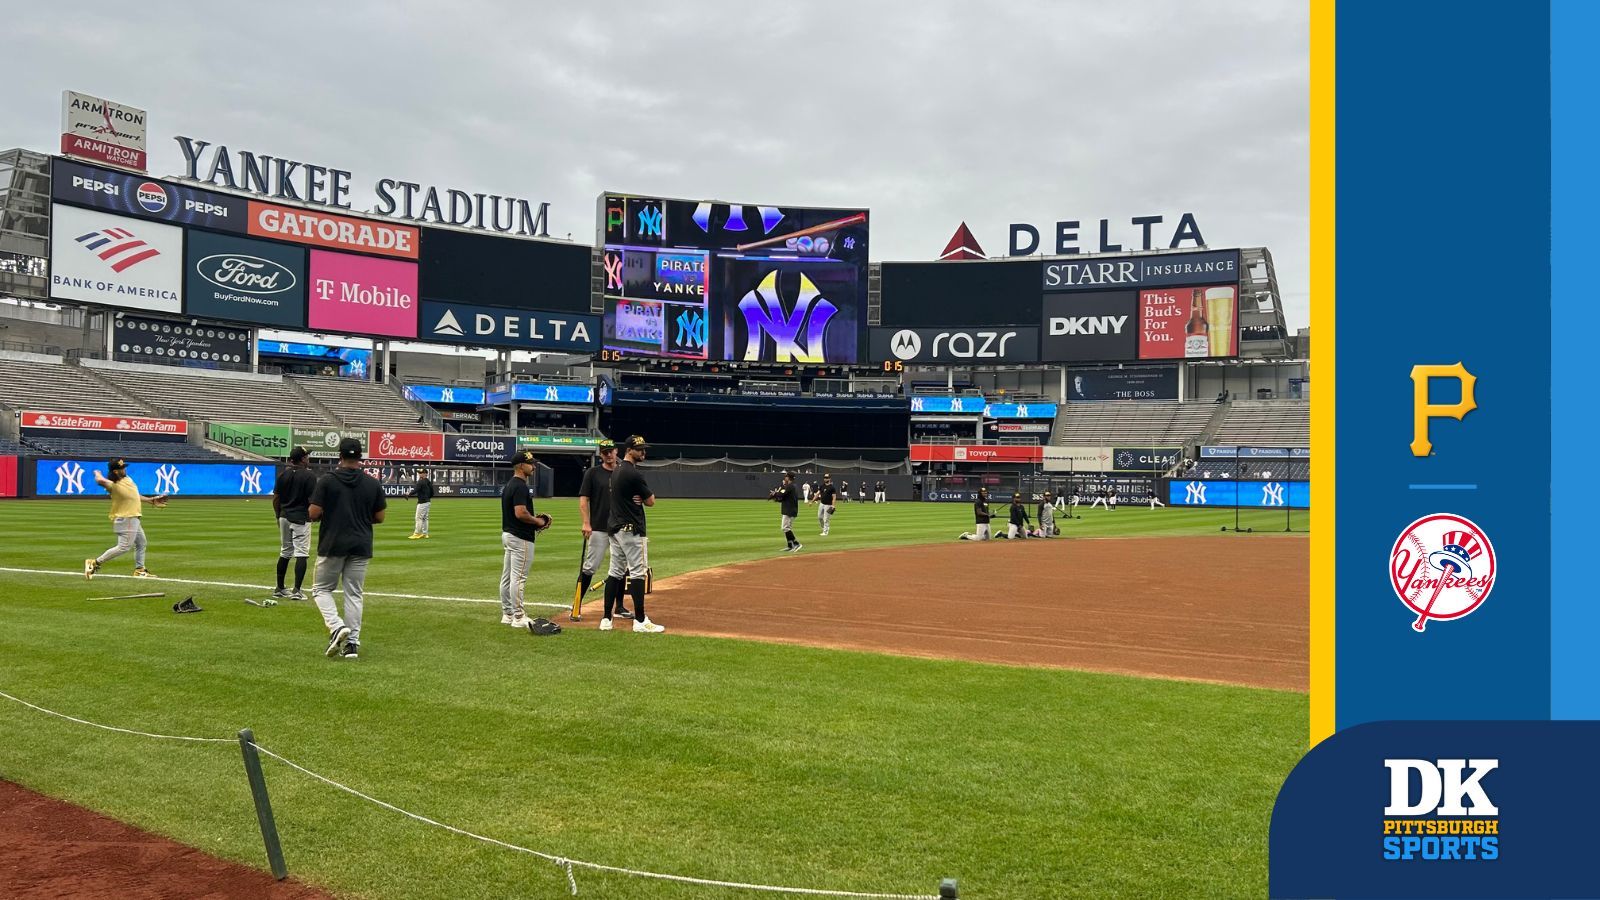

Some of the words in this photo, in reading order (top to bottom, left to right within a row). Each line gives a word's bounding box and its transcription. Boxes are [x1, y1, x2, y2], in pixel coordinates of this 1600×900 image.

[71, 98, 144, 125] ARMITRON
[74, 138, 139, 161] ARMITRON
[106, 153, 138, 167] WATCHES
[72, 175, 119, 196] PEPSI
[173, 135, 351, 209] YANKEE
[374, 178, 551, 237] STADIUM
[138, 191, 166, 204] PEPSI
[185, 199, 228, 217] PEPSI
[608, 207, 624, 232] P
[259, 209, 411, 252] GATORADE
[1009, 213, 1206, 256] DELTA
[214, 258, 280, 289] Ford
[1045, 261, 1138, 286] STARR
[1146, 259, 1234, 276] INSURANCE
[53, 275, 93, 290] BANK
[96, 281, 114, 292] OF
[117, 284, 178, 301] AMERICA
[340, 281, 411, 309] Mobile
[214, 292, 279, 307] BuyFordNow.com
[1143, 293, 1176, 304] This
[1143, 305, 1182, 318] Bud's
[475, 313, 591, 343] DELTA
[1049, 315, 1128, 336] DKNY
[1143, 318, 1167, 330] For
[932, 331, 1017, 358] razr
[1143, 331, 1174, 342] You.
[602, 350, 620, 361] 0:15
[884, 360, 902, 372] 0:15
[51, 416, 77, 427] State
[77, 418, 102, 428] Farm
[130, 420, 154, 430] State
[154, 422, 176, 432] Farm
[213, 430, 248, 446] Uber
[252, 434, 288, 448] Eats
[472, 440, 504, 453] coupa
[1140, 455, 1176, 466] CLEAR
[438, 486, 450, 494] 399
